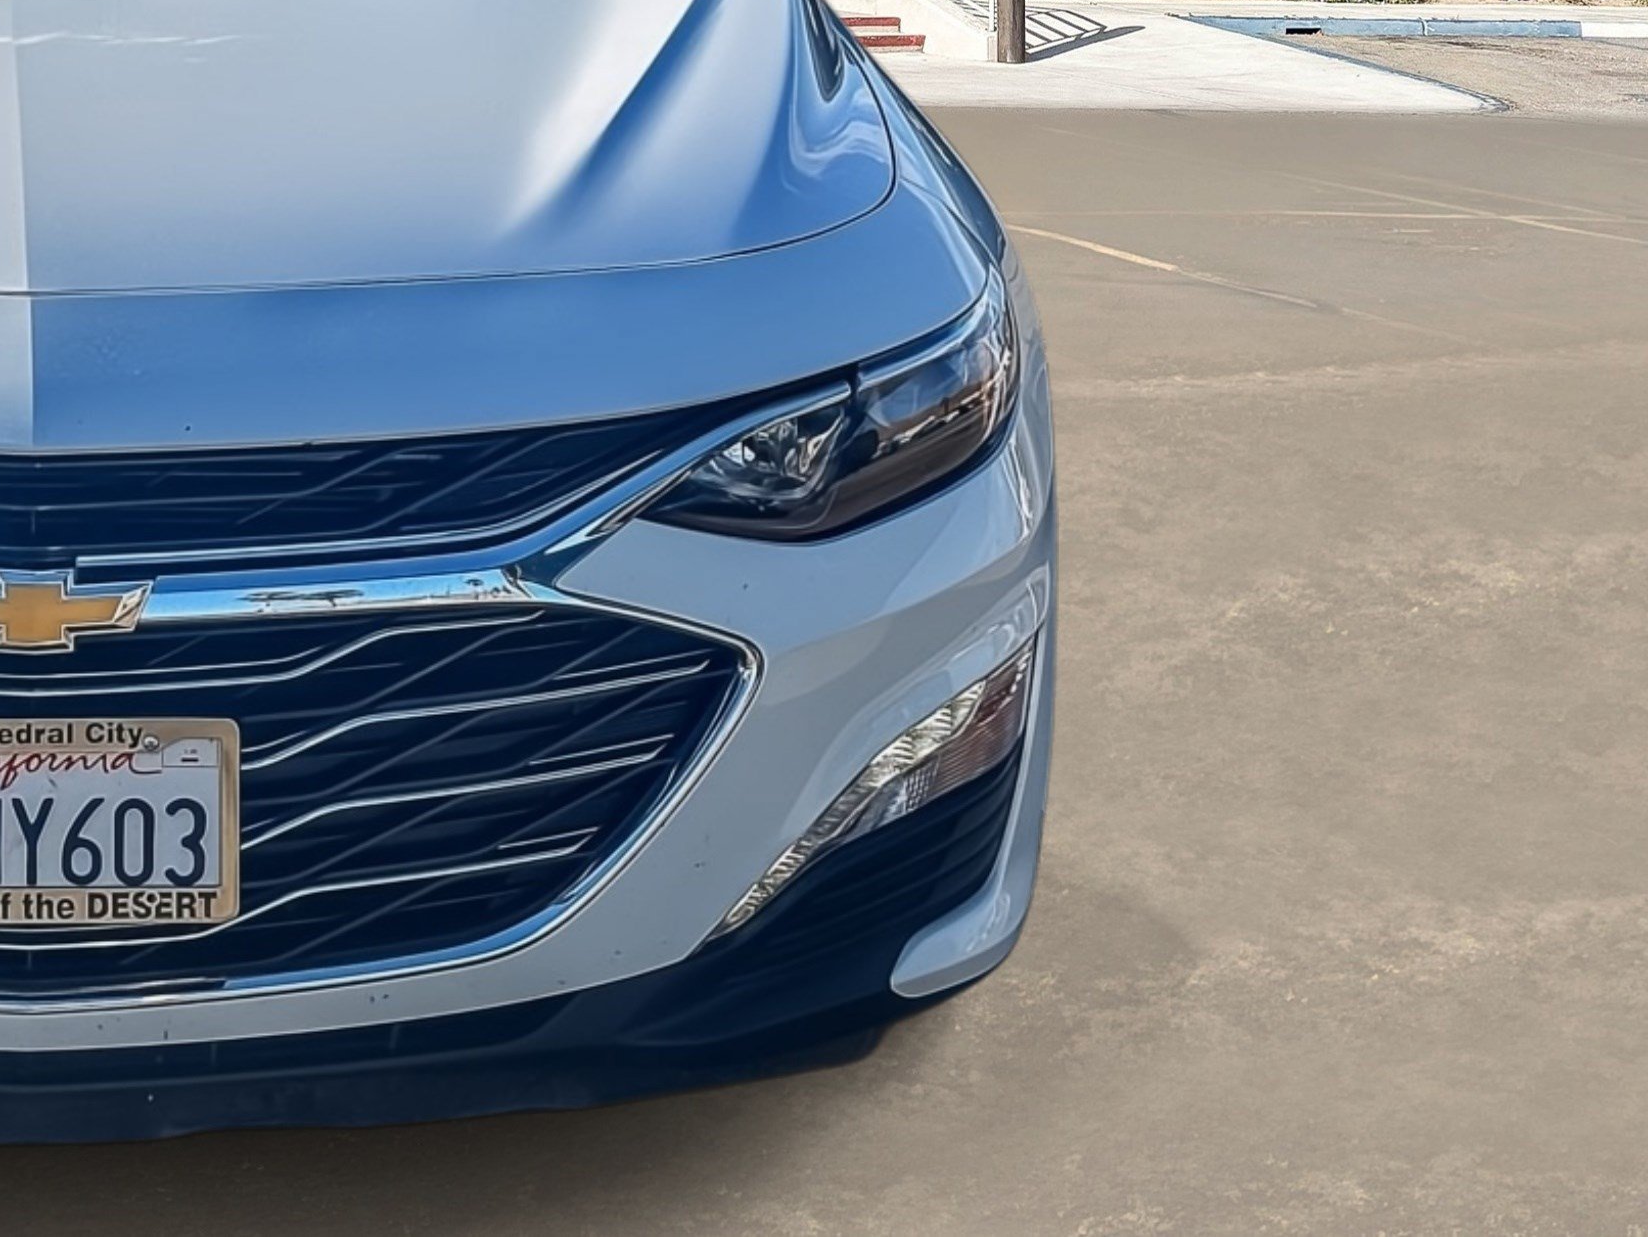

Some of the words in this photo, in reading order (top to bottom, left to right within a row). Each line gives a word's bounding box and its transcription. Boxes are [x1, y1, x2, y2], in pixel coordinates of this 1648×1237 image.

[85, 723, 143, 747] City
[21, 892, 75, 920] the
[87, 891, 218, 919] DESERT
